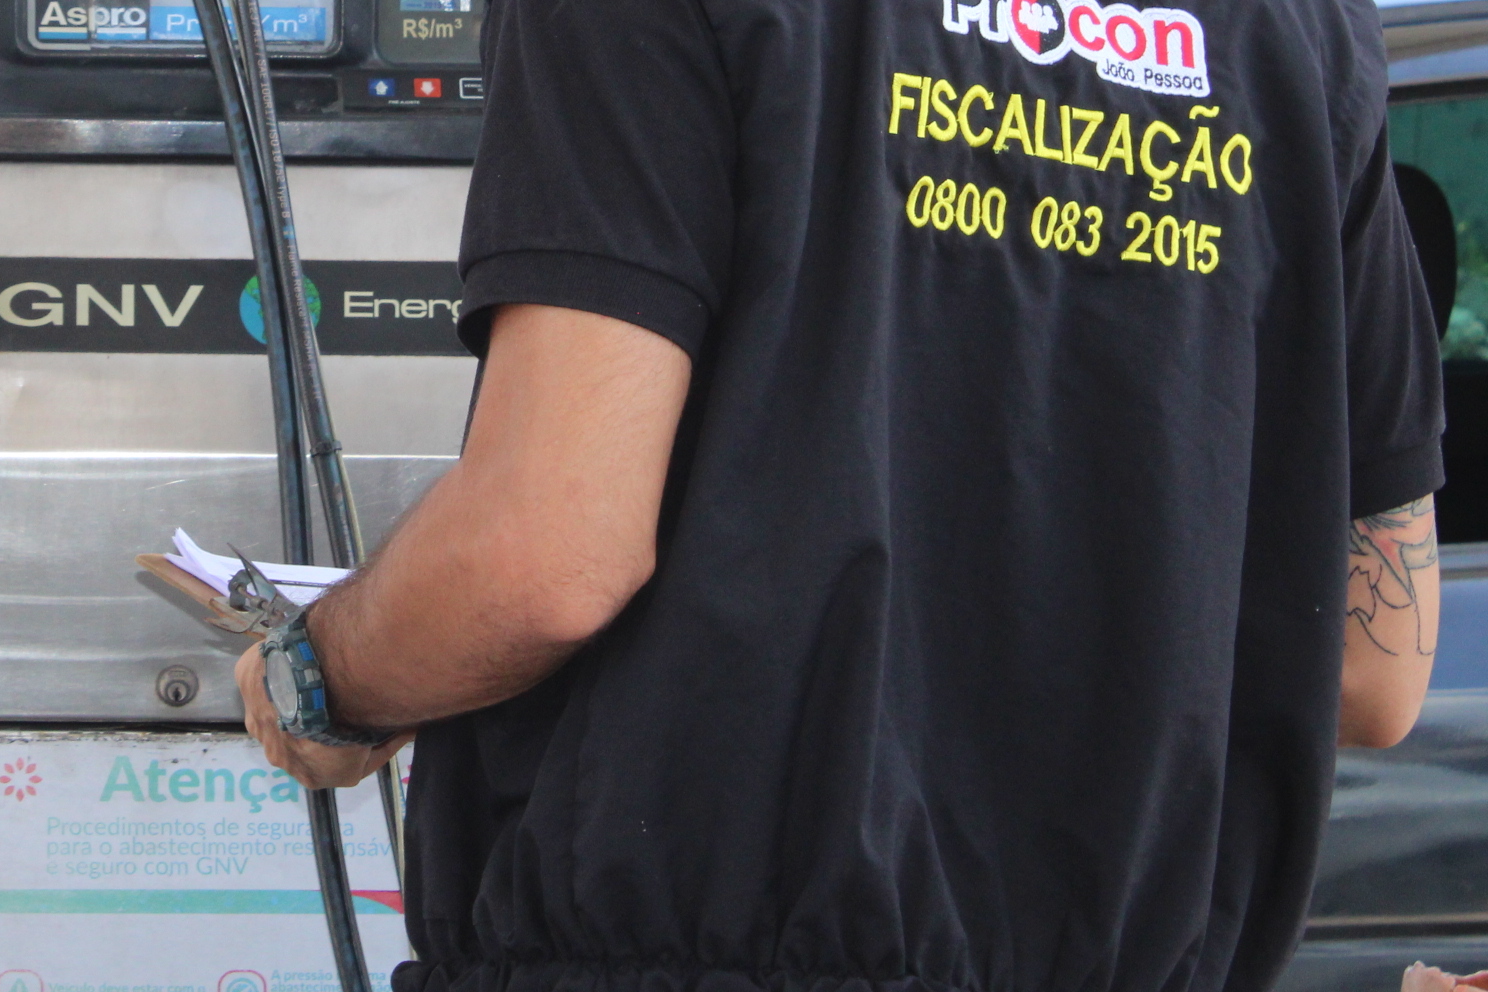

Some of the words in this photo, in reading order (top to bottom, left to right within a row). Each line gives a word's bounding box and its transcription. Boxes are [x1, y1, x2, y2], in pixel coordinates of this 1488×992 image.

[41, 1, 146, 35] Aspro
[1102, 58, 1135, 82] João
[1144, 68, 1203, 90] Pessoa
[888, 72, 1254, 202] FISCALIZAÇÃO
[906, 175, 1007, 240] 0800
[1030, 196, 1104, 257] 083
[1120, 211, 1222, 275] 2015
[46, 816, 207, 836] Procedimentos
[213, 817, 240, 836] de
[247, 821, 354, 840] seguraa
[46, 841, 93, 859] para
[99, 841, 112, 856] o
[118, 837, 277, 856] abastecimento
[65, 861, 138, 879] seguro
[144, 860, 190, 876] com
[196, 856, 249, 876] GNV
